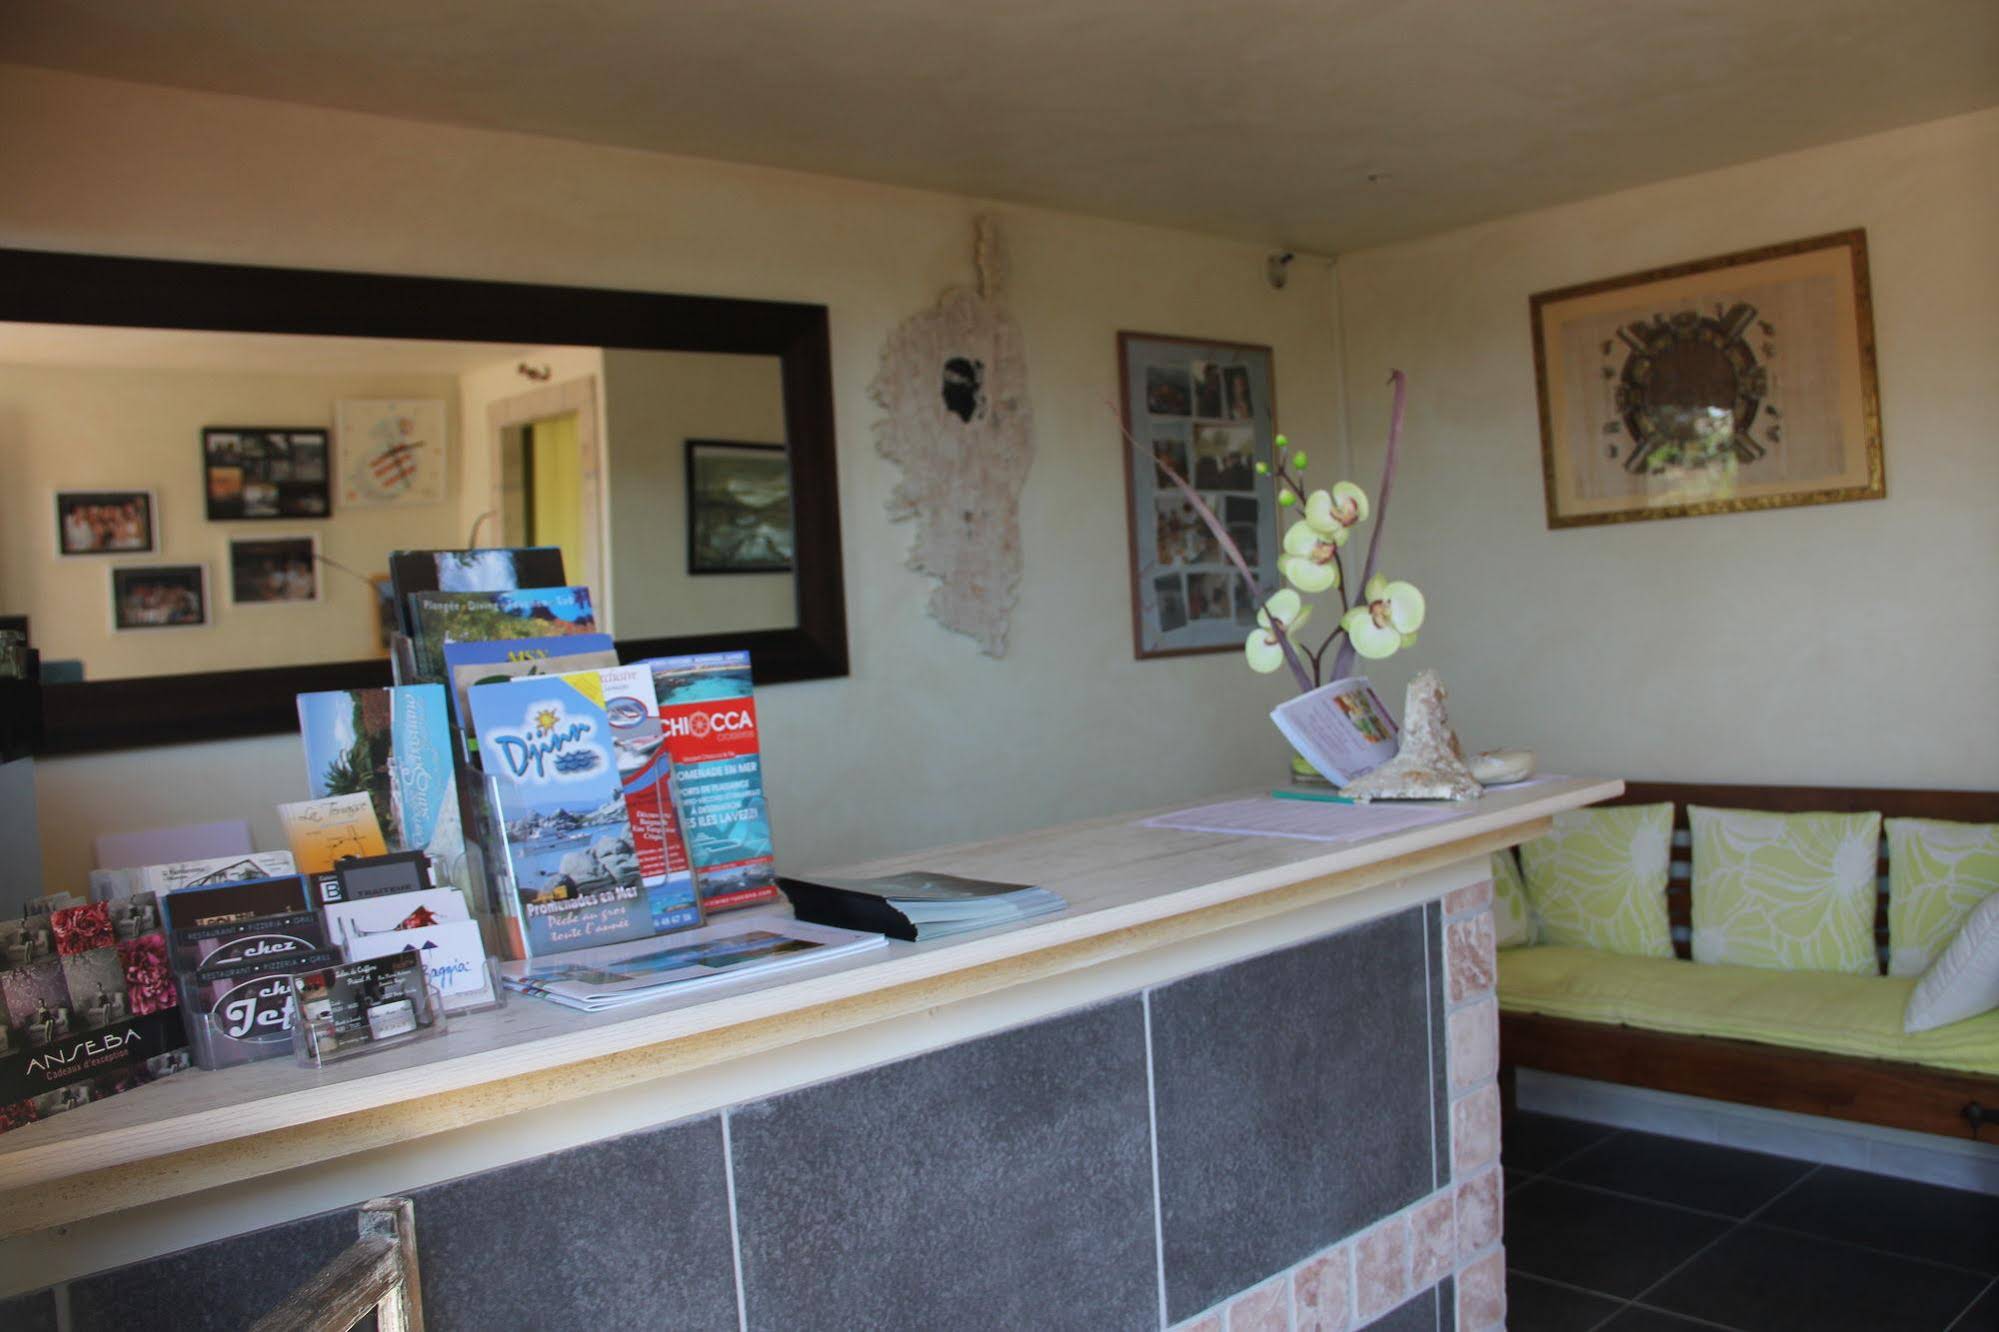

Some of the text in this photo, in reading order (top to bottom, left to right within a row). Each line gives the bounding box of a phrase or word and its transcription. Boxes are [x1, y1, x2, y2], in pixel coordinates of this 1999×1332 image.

[526, 885, 638, 917] Promenades en Mer
[187, 927, 237, 940] RESTAURANT
[247, 920, 282, 932] PIZZERIA
[244, 940, 296, 958] chez
[202, 967, 251, 981] RESTAURANT
[263, 960, 299, 972] PIZZERIA
[26, 1028, 141, 1076] ANSEBA
[47, 1064, 82, 1080] Cadeaux
